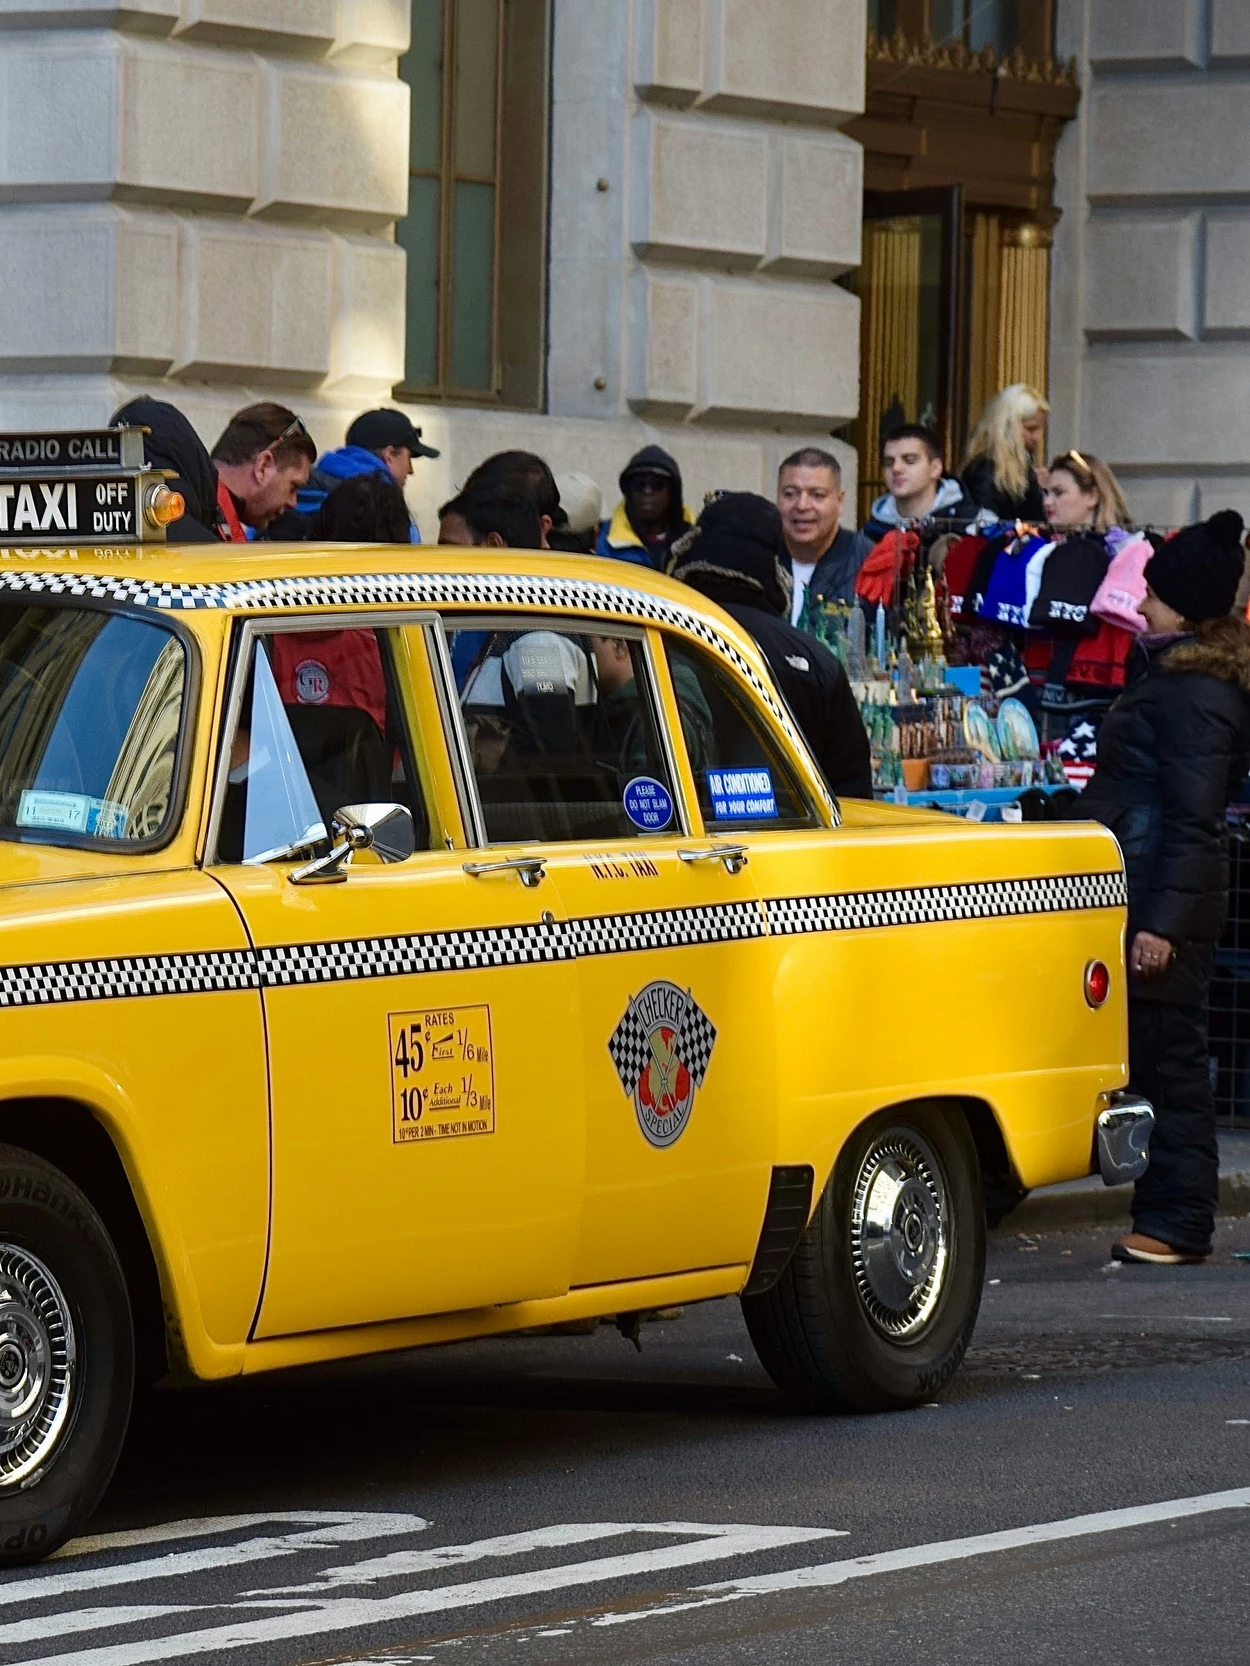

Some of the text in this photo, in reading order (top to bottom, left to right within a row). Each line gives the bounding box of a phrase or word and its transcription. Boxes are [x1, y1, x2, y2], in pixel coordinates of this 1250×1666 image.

[68, 438, 120, 460] CALL
[95, 482, 128, 505] OFF
[92, 511, 132, 532] DUTY
[1049, 601, 1088, 622] NYC
[635, 785, 656, 797] PLEASE
[709, 772, 771, 795] AIR CONDITIONED
[629, 798, 668, 811] DO NOT SLAM
[715, 798, 775, 815] FOR YOUR COMFORT
[68, 809, 81, 820] 17
[643, 812, 660, 824] DOOR
[621, 851, 659, 878] TAXI
[637, 987, 684, 1027] CHECKER
[425, 1012, 455, 1027] RATES
[476, 1046, 489, 1063] Mile
[433, 1082, 453, 1095] Each
[429, 1096, 461, 1107] Additional
[479, 1095, 492, 1111] Mile
[438, 1123, 450, 1135] TIME
[450, 1121, 461, 1133] NOT
[462, 1120, 467, 1132] IN
[468, 1119, 488, 1131] MOTION
[644, 1107, 684, 1134] SPECIAL
